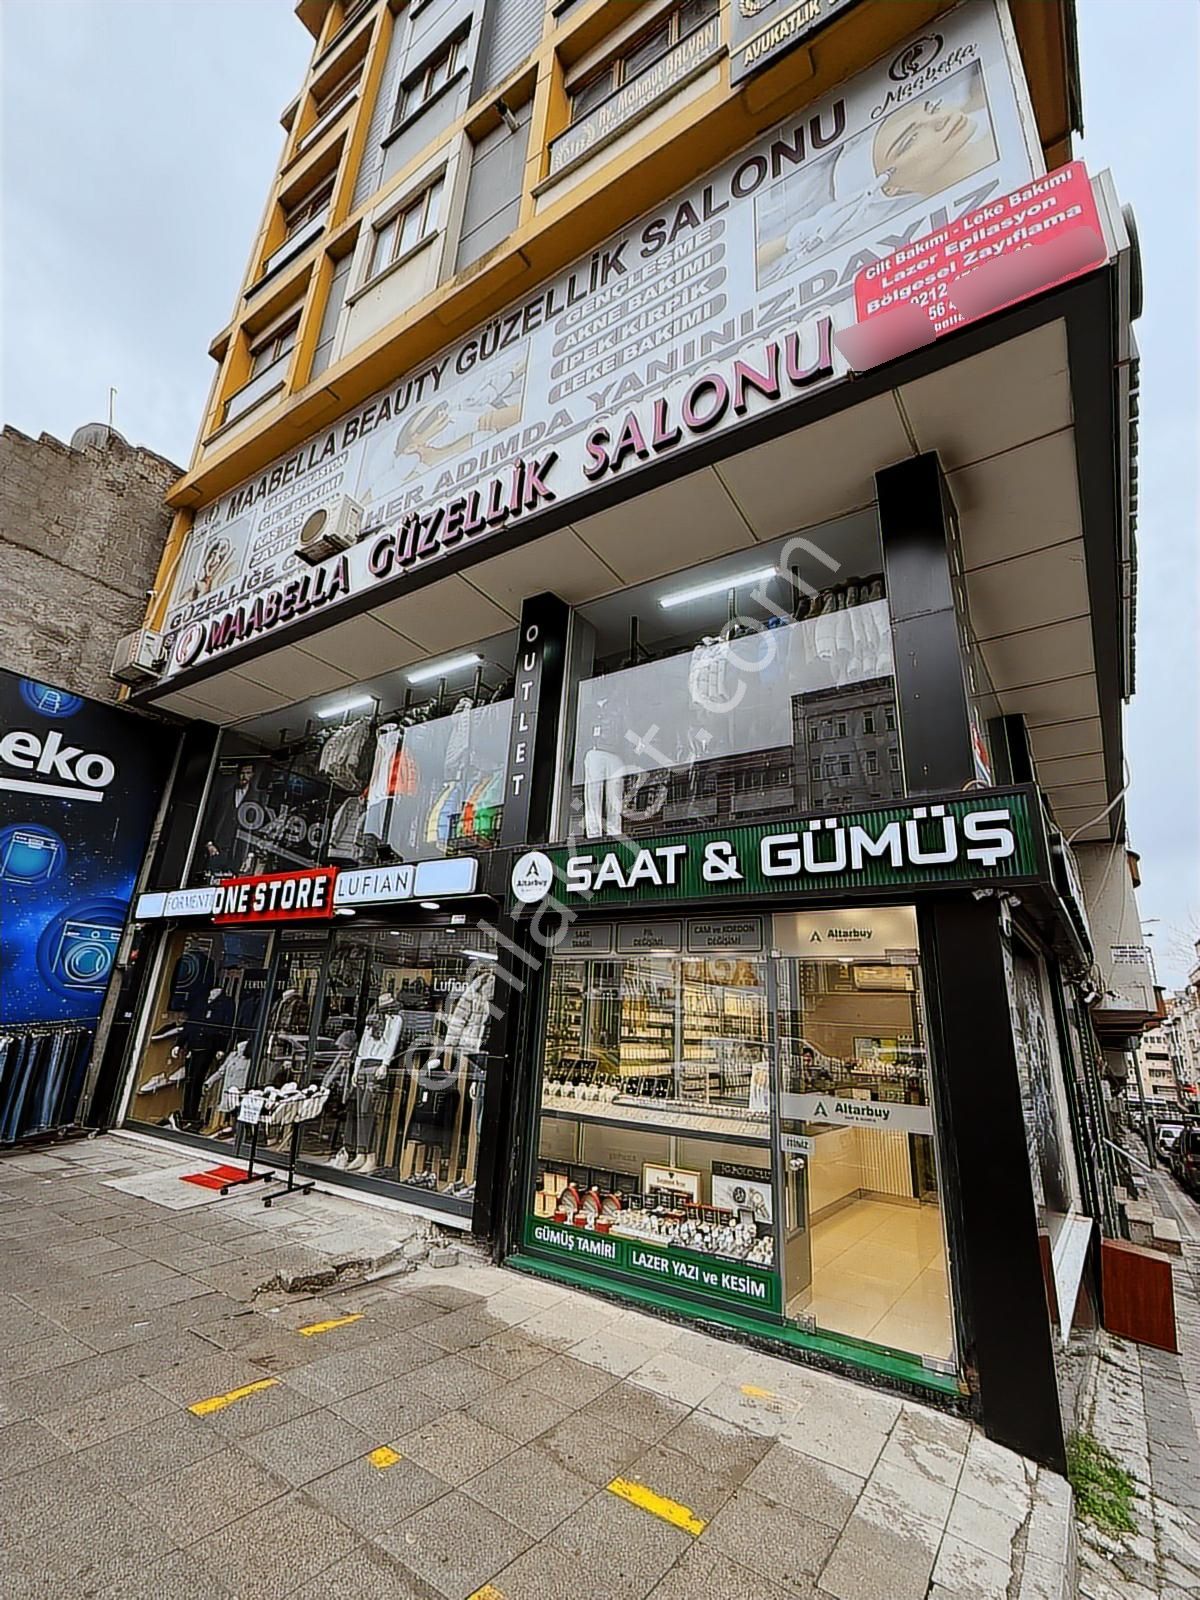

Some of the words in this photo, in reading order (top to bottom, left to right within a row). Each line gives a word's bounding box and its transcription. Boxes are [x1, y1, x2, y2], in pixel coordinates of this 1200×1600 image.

[744, 0, 821, 67] AVUKATLIK
[866, 262, 957, 315] Bölgesel
[963, 204, 1082, 267] Zayıflama
[881, 252, 938, 289] Lazer
[945, 196, 1057, 257] Epilasyon
[895, 231, 949, 265] Bakımı
[1008, 169, 1073, 208] Bakımı
[226, 432, 335, 521] MAABELLA
[341, 357, 453, 449] BEAUTY
[456, 239, 631, 376] GÜZELLİK
[641, 99, 846, 258] SALONU
[563, 304, 622, 350] AKNE
[627, 251, 712, 307] BAKIMI
[565, 225, 713, 326] GENÇLEŞME
[559, 355, 617, 398] LEKE
[623, 300, 712, 363] BAKIMI
[206, 555, 350, 654] MAABELLA
[369, 450, 559, 578] GÜZELLİK
[583, 314, 835, 481] SALONU
[365, 485, 423, 530] HER
[433, 407, 575, 498] ADIMDA
[511, 623, 539, 798] OUTLET
[0, 729, 115, 788] eko
[337, 871, 409, 898] LUFIAN
[565, 844, 687, 892] SAAT
[701, 841, 744, 883] &
[760, 804, 1016, 878] GÜMÜŞ
[213, 884, 250, 915] ONE
[253, 875, 327, 912] STORE
[828, 928, 872, 939] Altarbuy
[433, 977, 468, 993] Lufian
[834, 1102, 890, 1121] Altarbuy
[534, 1225, 575, 1249] GÜMÜŞ
[576, 1236, 616, 1259] TAMİRİ
[632, 1250, 669, 1273] LAZER
[672, 1260, 699, 1281] YAZI
[702, 1271, 718, 1285] ve
[721, 1273, 765, 1298] KESİM
